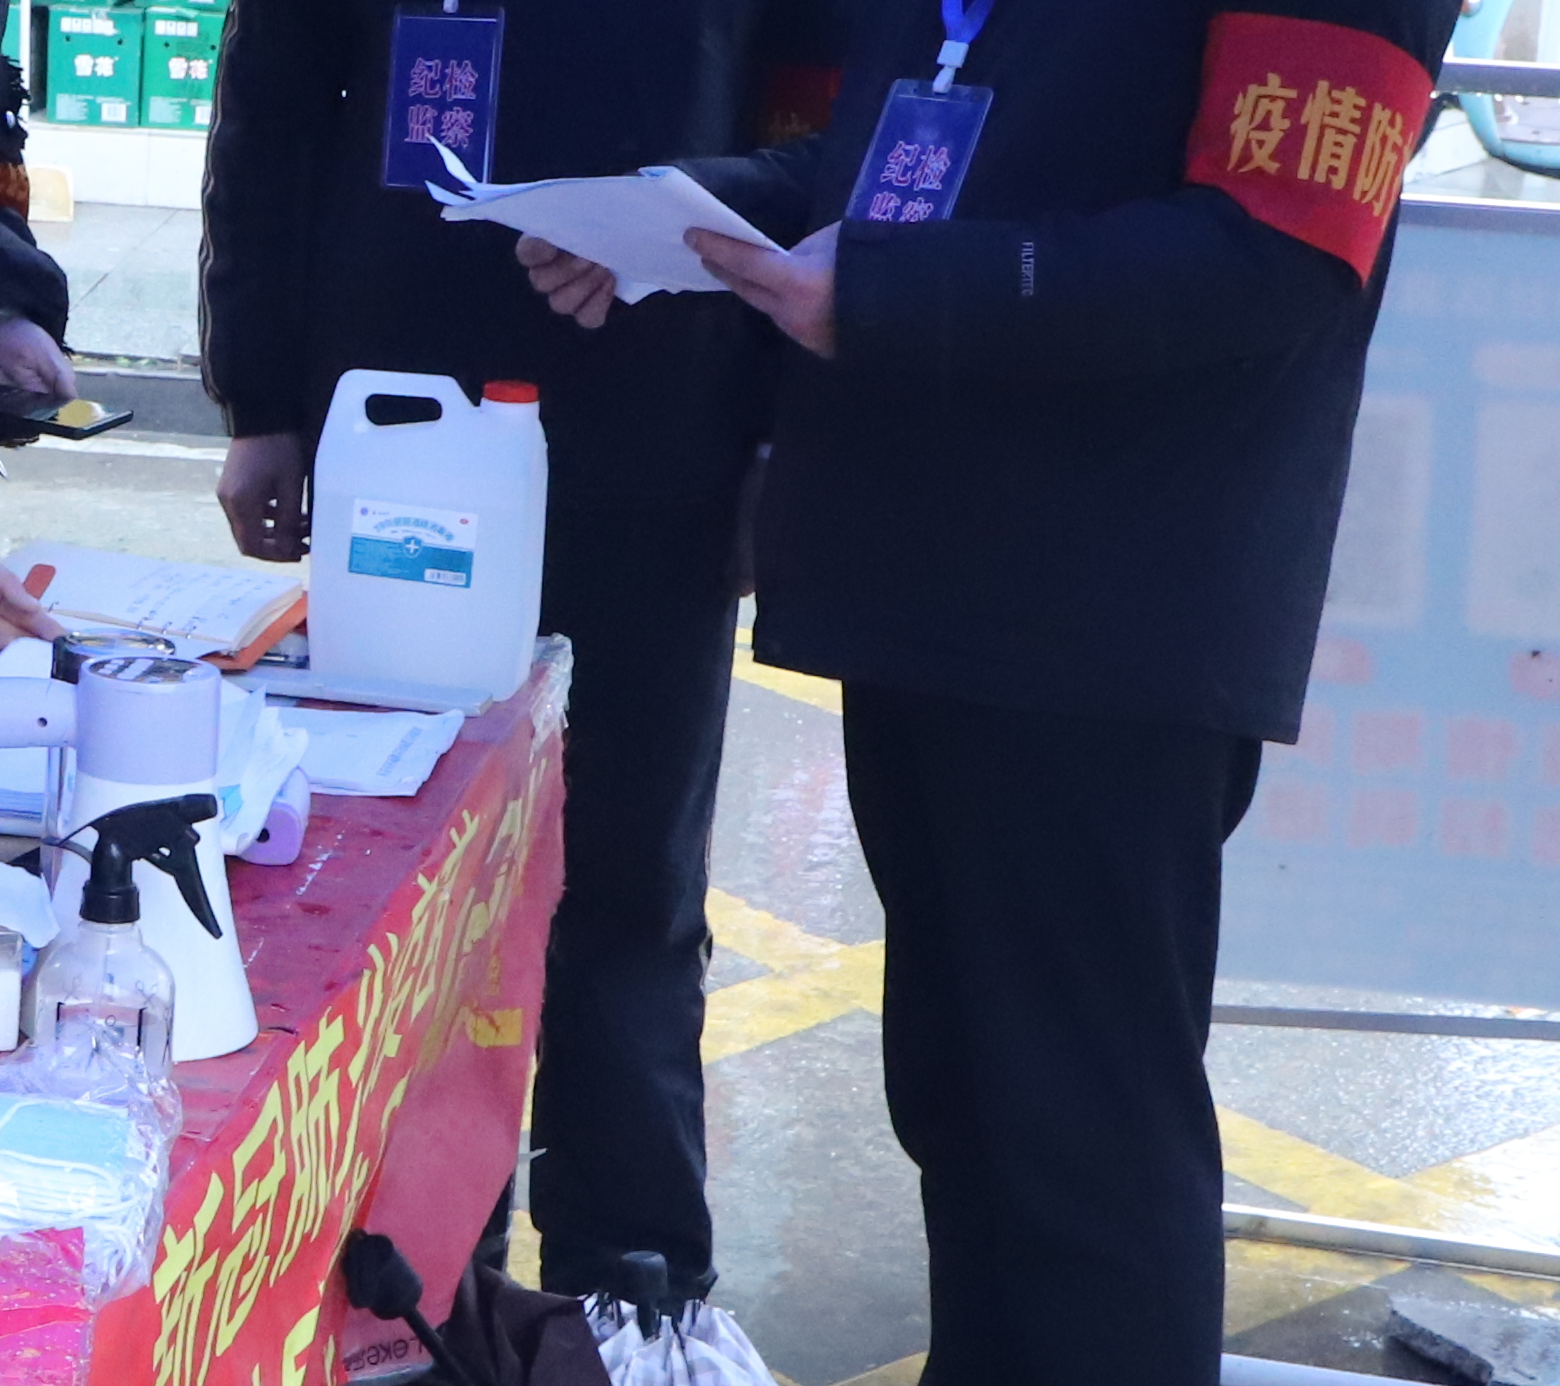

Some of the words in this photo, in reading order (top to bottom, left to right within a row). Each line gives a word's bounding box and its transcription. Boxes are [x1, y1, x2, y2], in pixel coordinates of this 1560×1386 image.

[408, 57, 480, 103] 纪检
[403, 103, 475, 149] 监察
[1226, 71, 1416, 227] 疫情防
[880, 141, 952, 191] 纪检
